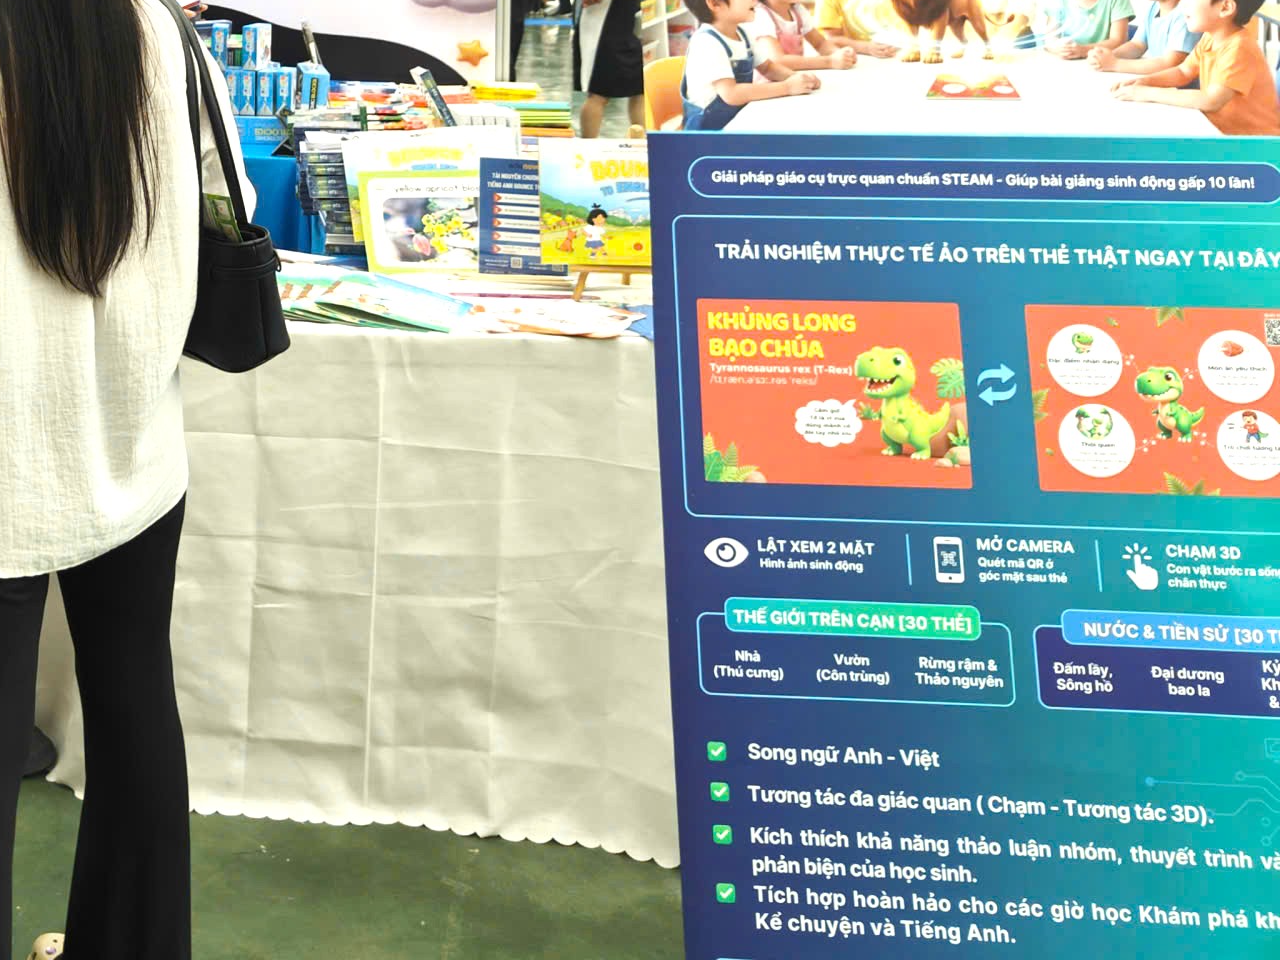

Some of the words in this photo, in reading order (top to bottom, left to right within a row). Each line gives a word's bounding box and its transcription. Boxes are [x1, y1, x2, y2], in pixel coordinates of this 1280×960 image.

[708, 306, 788, 334] KHỦNG
[792, 313, 856, 333] LONG
[709, 338, 756, 363] BẠO
[761, 334, 825, 359] CHÚA
[758, 536, 787, 555] LẬT
[790, 540, 823, 554] XEM
[828, 541, 836, 554] 2
[840, 540, 875, 558] MẶT
[977, 537, 1003, 552] MỞ
[1006, 540, 1075, 554] CAMERA
[733, 607, 768, 624] THẾ
[770, 609, 806, 626] GIỚI
[809, 610, 853, 628] TRÊN
[857, 613, 894, 632] CẠN
[899, 615, 927, 632] [30
[931, 614, 972, 634] THẺ]
[747, 743, 797, 766] Song
[800, 743, 839, 769] ngữ
[843, 745, 883, 765] Anh
[900, 746, 940, 770] Việt
